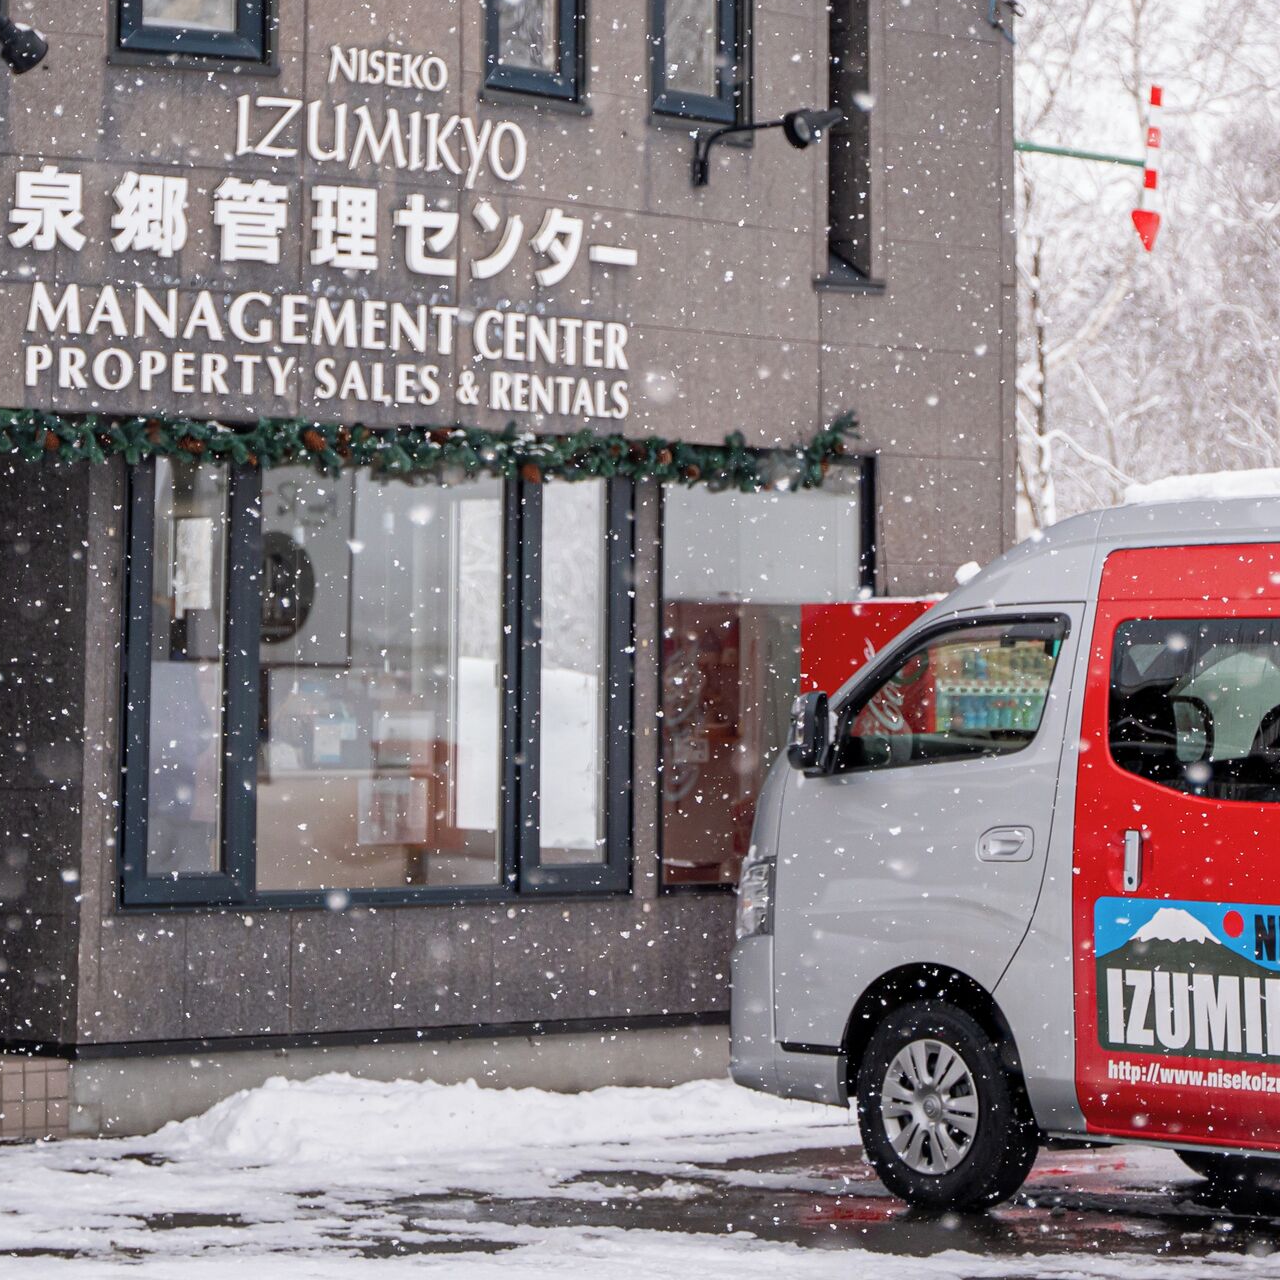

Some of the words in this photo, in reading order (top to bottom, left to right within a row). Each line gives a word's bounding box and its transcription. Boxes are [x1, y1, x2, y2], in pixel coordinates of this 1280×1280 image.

[327, 44, 449, 93] NISEKO
[235, 94, 528, 189] IZUMIKYO
[8, 165, 639, 287] 泉郷管理センター
[26, 281, 460, 356] MANAGEMENT
[473, 309, 629, 370] CENTER
[25, 345, 297, 397] PROPERTY
[314, 357, 441, 407] SALES
[455, 370, 481, 406] &
[489, 371, 630, 420] RENTALS
